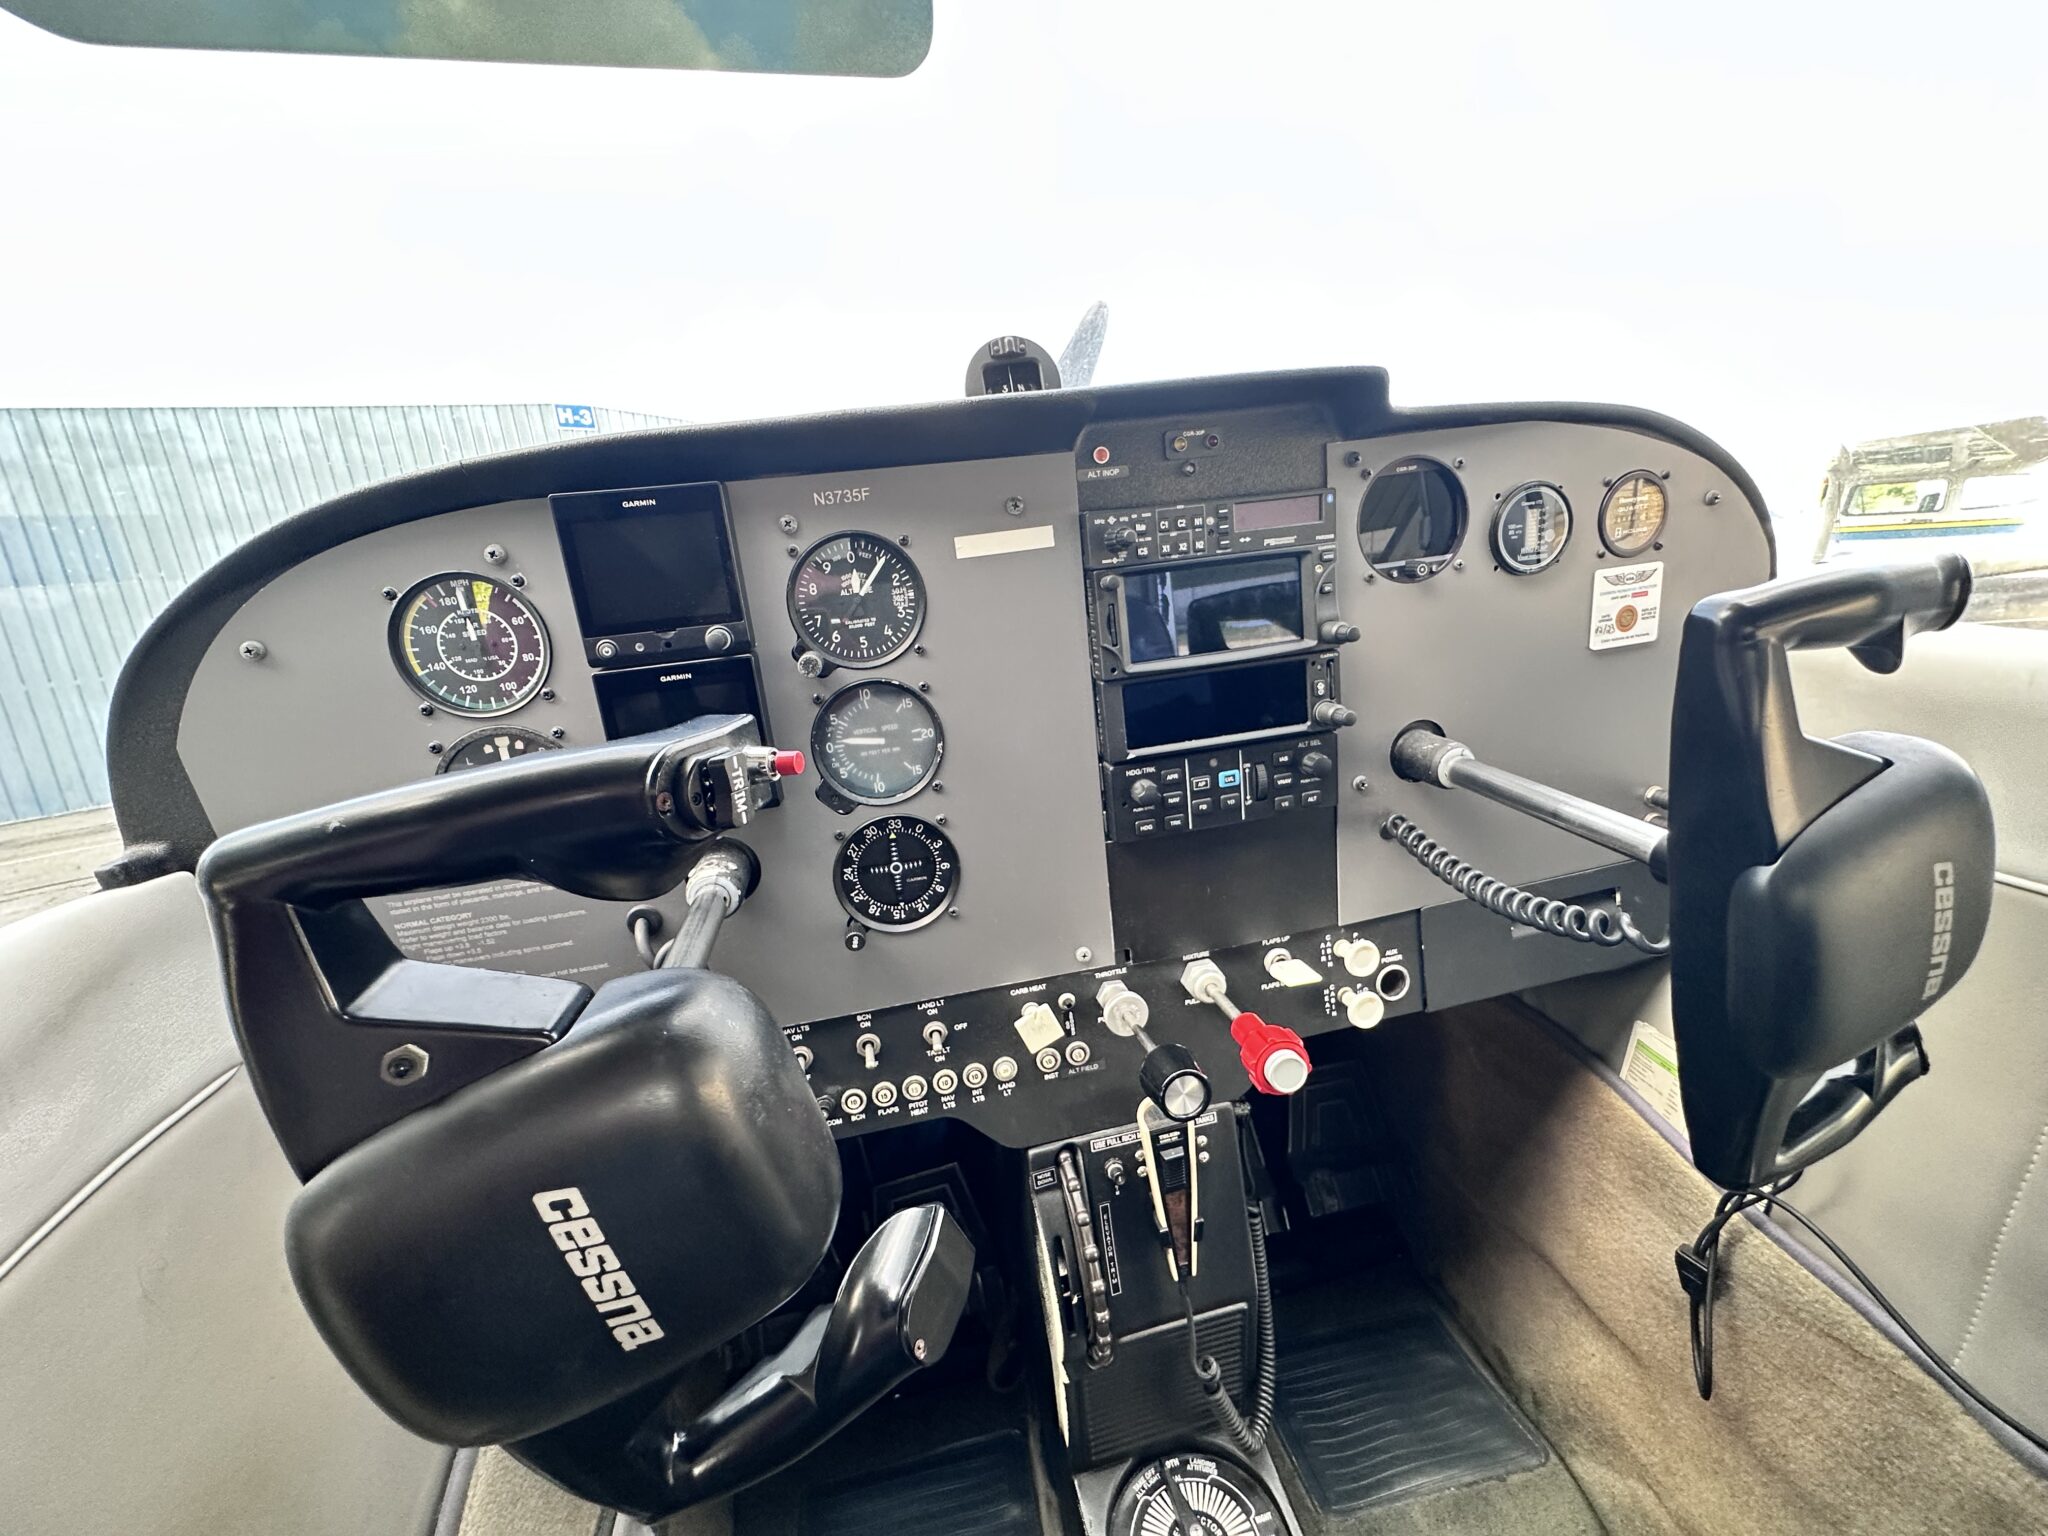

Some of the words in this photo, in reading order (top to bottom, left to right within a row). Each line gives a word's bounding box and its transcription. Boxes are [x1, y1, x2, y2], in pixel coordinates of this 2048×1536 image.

[557, 408, 592, 425] H-3
[1088, 470, 1101, 478] ALT
[1102, 468, 1120, 476] INOP
[813, 488, 870, 506] N3735F
[622, 499, 656, 508] GARMIN
[1160, 521, 1168, 529] C1
[1178, 519, 1186, 527] C2
[1162, 545, 1170, 553] X1
[1179, 542, 1188, 550] X2
[846, 551, 856, 564] 0
[822, 562, 832, 574] 9
[450, 579, 470, 588] MPH
[892, 573, 900, 586] 2
[808, 583, 818, 596] 8
[439, 597, 458, 606] 180
[897, 606, 906, 618] 3
[512, 616, 524, 626] 60
[814, 615, 822, 627] 7
[419, 625, 438, 636] 160
[884, 624, 893, 636] 4
[832, 630, 840, 642] 6
[860, 636, 868, 648] 5
[522, 652, 534, 662] 80
[428, 662, 446, 672] 140
[660, 673, 692, 682] GARMIN
[460, 684, 478, 694] 120
[500, 682, 518, 692] 100
[859, 688, 870, 700] 10
[902, 698, 912, 708] 15
[830, 714, 838, 724] 5
[853, 727, 877, 735] VERTICAL
[881, 724, 898, 732] SPEED
[921, 728, 934, 739] 20
[826, 742, 834, 754] 0
[466, 757, 474, 766] L
[840, 768, 848, 778] 5
[912, 764, 922, 776] 15
[1126, 767, 1156, 776] HDG/TRK
[732, 767, 748, 813] TRIM
[874, 782, 886, 793] 10
[888, 819, 902, 829] 33
[916, 824, 924, 833] 0
[864, 826, 878, 838] 30
[933, 840, 942, 848] 3
[847, 843, 859, 858] 27
[844, 867, 854, 880] 24
[935, 884, 944, 892] 9
[850, 890, 864, 902] 21
[868, 904, 882, 916] 18
[916, 902, 930, 912] 12
[892, 910, 906, 920] 15
[394, 920, 430, 930] NORMAL
[430, 912, 472, 924] CATEGORY
[1262, 936, 1281, 946] FLAPS
[1182, 950, 1210, 960] MIXTURE
[1381, 954, 1403, 964] POWER
[1094, 967, 1128, 978] THROTTLE
[1010, 987, 1029, 996] CARB
[1030, 984, 1047, 992] HEAT
[1261, 981, 1280, 990] FLAPS
[918, 1002, 936, 1010] LAND
[954, 1022, 968, 1030] OFF
[1068, 1066, 1080, 1074] ALT
[1080, 1064, 1099, 1072] FIELD
[1044, 1072, 1059, 1080] INST
[998, 1081, 1016, 1090] LAND
[972, 1095, 985, 1103] LTS
[908, 1100, 928, 1110] PITOT
[943, 1101, 956, 1110] LTS
[878, 1106, 899, 1116] FLAPS
[910, 1107, 928, 1116] HEAT
[851, 1113, 866, 1121] BCN
[1094, 1140, 1106, 1149] USE
[1106, 1137, 1121, 1146] FULL
[1122, 1133, 1136, 1141] RICH
[1195, 1115, 1214, 1125] TANKS
[1037, 1177, 1054, 1186] DOWN
[1104, 1214, 1113, 1257] ELEVATOR
[1132, 1478, 1145, 1491] TAKE
[1144, 1468, 1156, 1481] OFF
[1136, 1488, 1146, 1500] ALL
[1144, 1472, 1161, 1490] FLIGHT
